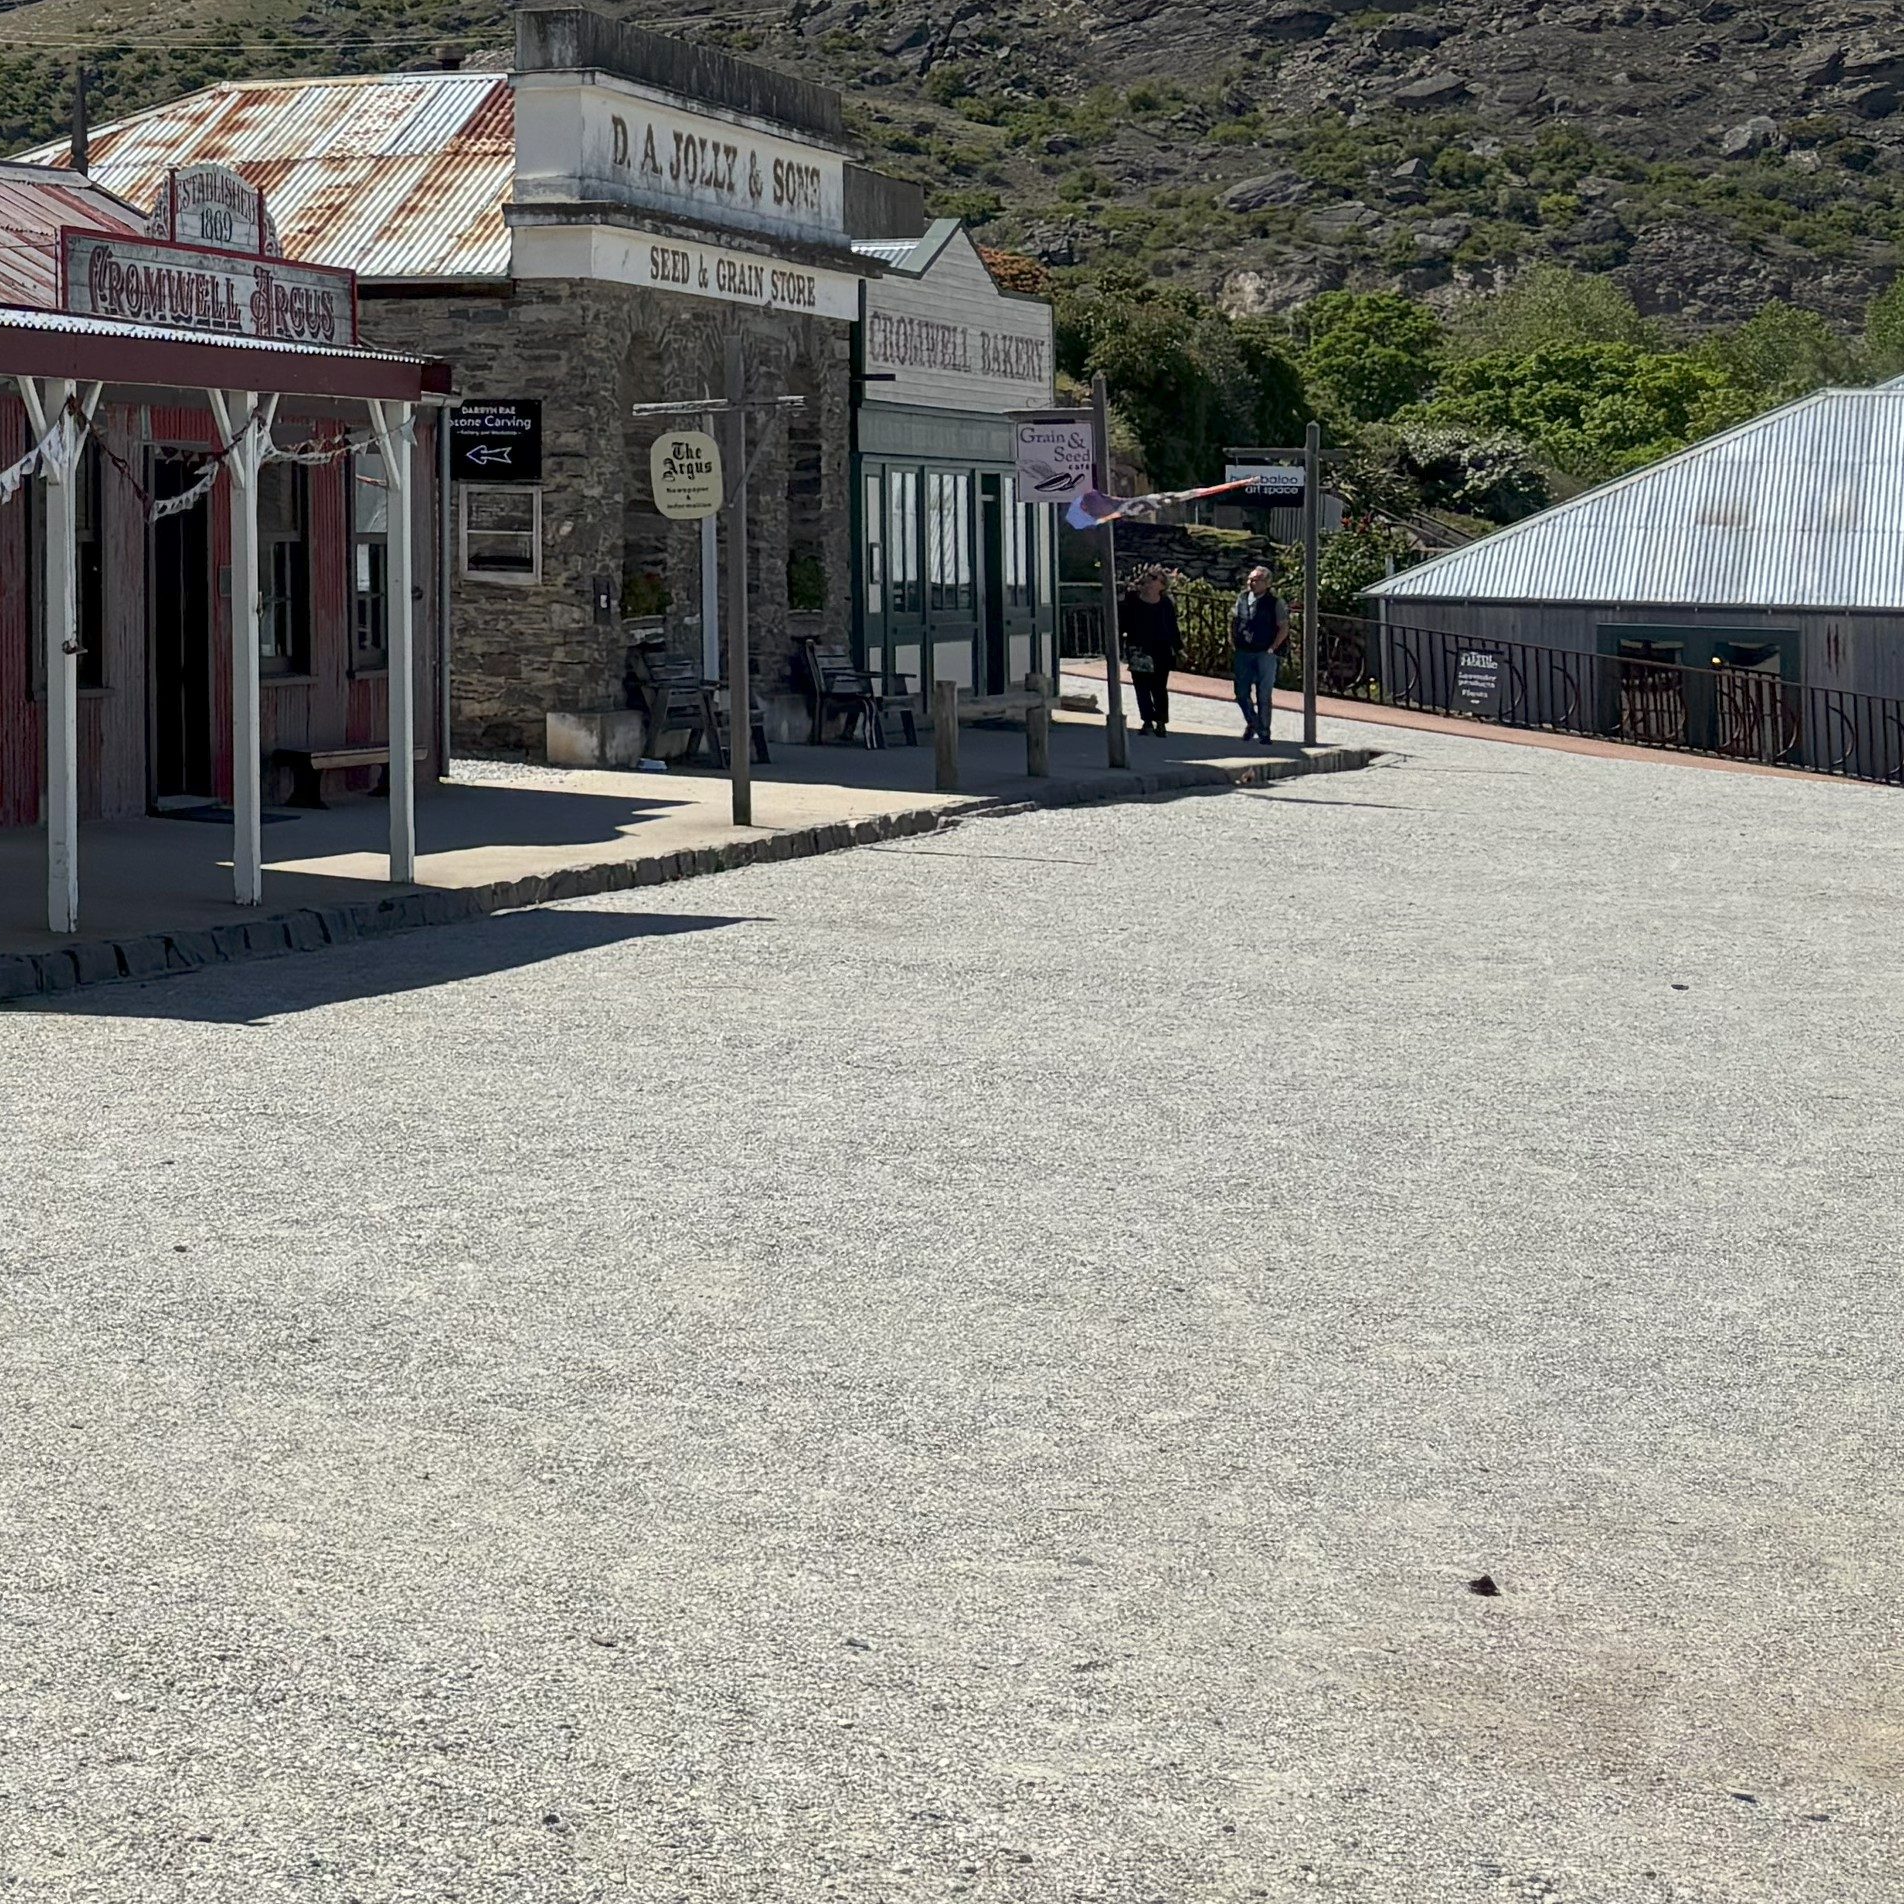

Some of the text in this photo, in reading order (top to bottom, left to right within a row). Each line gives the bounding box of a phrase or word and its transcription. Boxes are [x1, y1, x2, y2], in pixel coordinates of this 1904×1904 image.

[610, 114, 632, 169] D.
[641, 122, 663, 176] A.
[669, 129, 738, 193] JOLLY
[748, 149, 764, 198] &
[177, 171, 255, 224] ESTABLISHED
[201, 208, 233, 242] 1869
[88, 245, 242, 330] CROMWELL
[649, 245, 816, 307] SEED & GRAIN STORE
[867, 311, 1046, 383] CROMWELL BAKERY
[484, 415, 532, 431] Carving
[1020, 426, 1065, 443] Grain
[1068, 431, 1086, 449] &
[672, 441, 702, 460] The
[1054, 445, 1090, 462] Seed
[661, 457, 712, 481] Argus
[1264, 486, 1298, 495] space
